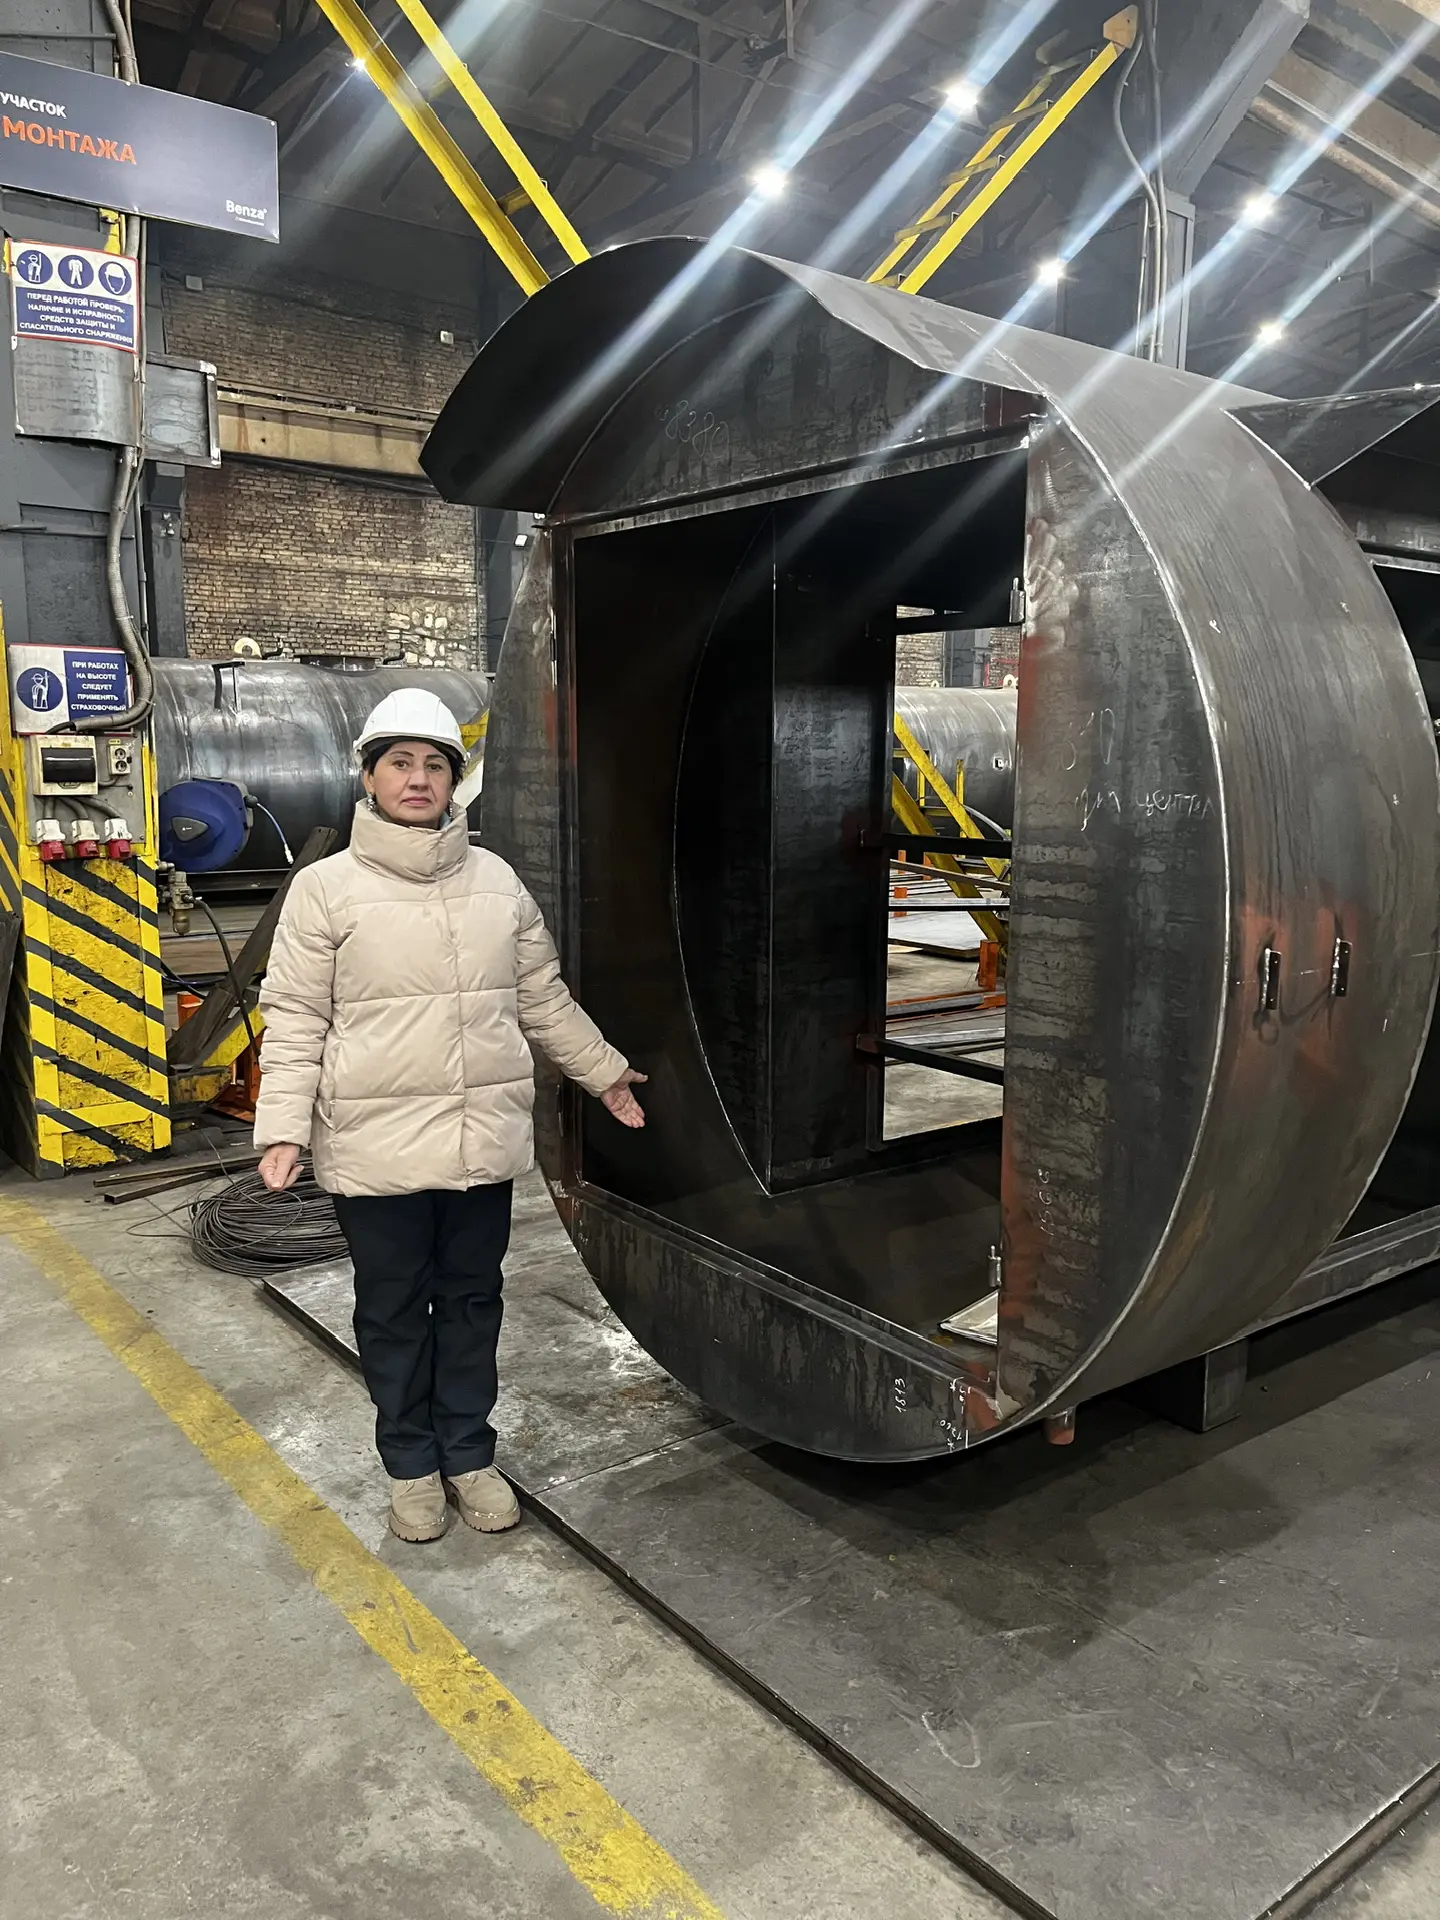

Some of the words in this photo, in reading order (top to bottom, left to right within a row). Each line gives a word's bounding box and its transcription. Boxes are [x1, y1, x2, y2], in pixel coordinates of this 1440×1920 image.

[0, 91, 67, 118] УЧАСТОК
[2, 115, 137, 165] МОНТАЖА
[27, 292, 52, 304] ПЕРЕД
[53, 295, 89, 307] РАБОТОЙ
[28, 304, 64, 314] НАЛИЧИЕ
[72, 308, 125, 323] ИСПРАВНОСТЬ
[40, 314, 74, 324] СРЕДСТВ
[75, 318, 109, 329] ЗАЩИТЫ
[109, 322, 116, 330] И
[19, 322, 84, 335] СПАСАТЕЛЬНОГО
[85, 327, 133, 344] СНАРЯЖЕНИЯ
[88, 661, 119, 670] РАБОТАХ
[82, 683, 112, 691] СЛЕДУЕТ
[77, 693, 119, 701] ПРИМЕНЯТЬ
[71, 703, 127, 711] СТРАХОВОЧНЫЙ
